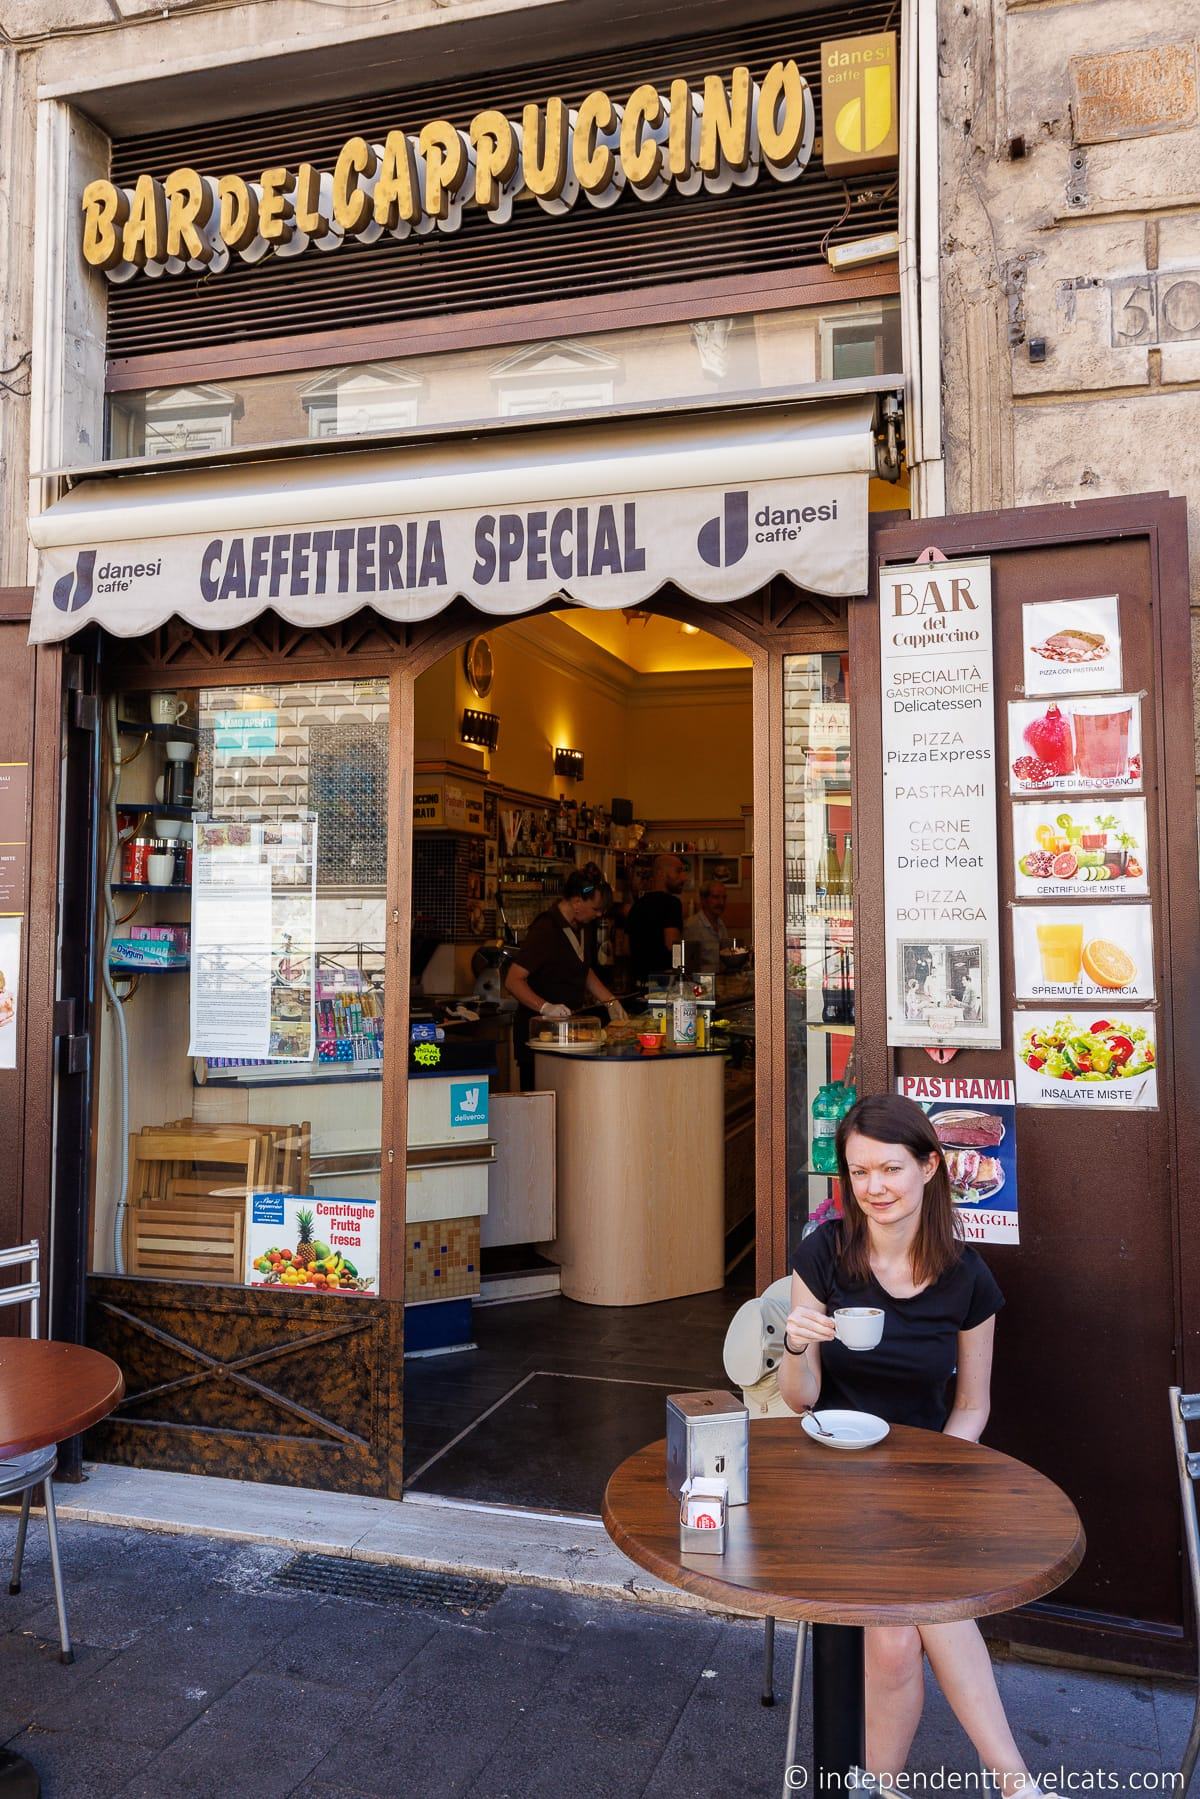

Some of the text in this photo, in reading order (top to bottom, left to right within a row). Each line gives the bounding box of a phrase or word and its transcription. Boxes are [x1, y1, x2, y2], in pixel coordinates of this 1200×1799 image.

[828, 44, 891, 67] danesi
[82, 59, 804, 266] BAR DEL CAPPUCCINO
[755, 499, 837, 527] danesi
[200, 502, 646, 602] CAFFETTERIA SPECIAL
[98, 559, 162, 579] danesi
[891, 578, 980, 617] BAR
[923, 616, 946, 630] del
[892, 629, 980, 648] Cappuccino
[893, 665, 982, 685] SPECIALITÀ
[886, 683, 990, 699] GASTRONOMICHE
[894, 699, 982, 713] Delicatessen
[912, 732, 964, 746] PIZZA
[1019, 780, 1065, 789] SPREMUTE
[1078, 778, 1134, 788] MELOGRANO
[895, 784, 984, 799] PASTRAMI
[909, 820, 971, 834] CARNE
[910, 838, 970, 851] SECCA
[898, 855, 984, 868] Dried Meat
[915, 890, 967, 903] PIZZA
[1037, 885, 1126, 894] CENTRIFUGHE MISTE
[896, 907, 987, 921] BOTTARGA
[116, 944, 144, 961] Daygum
[1032, 986, 1138, 995] SPREMUTE D'ARANCIA
[903, 1077, 1010, 1100] PASTRAMI
[1041, 1088, 1133, 1100] INSALATE MISTE
[454, 1114, 485, 1122] deliveroo
[316, 1203, 375, 1219] Centrifughe
[330, 1219, 361, 1231] Frutta
[330, 1234, 361, 1246] fresca
